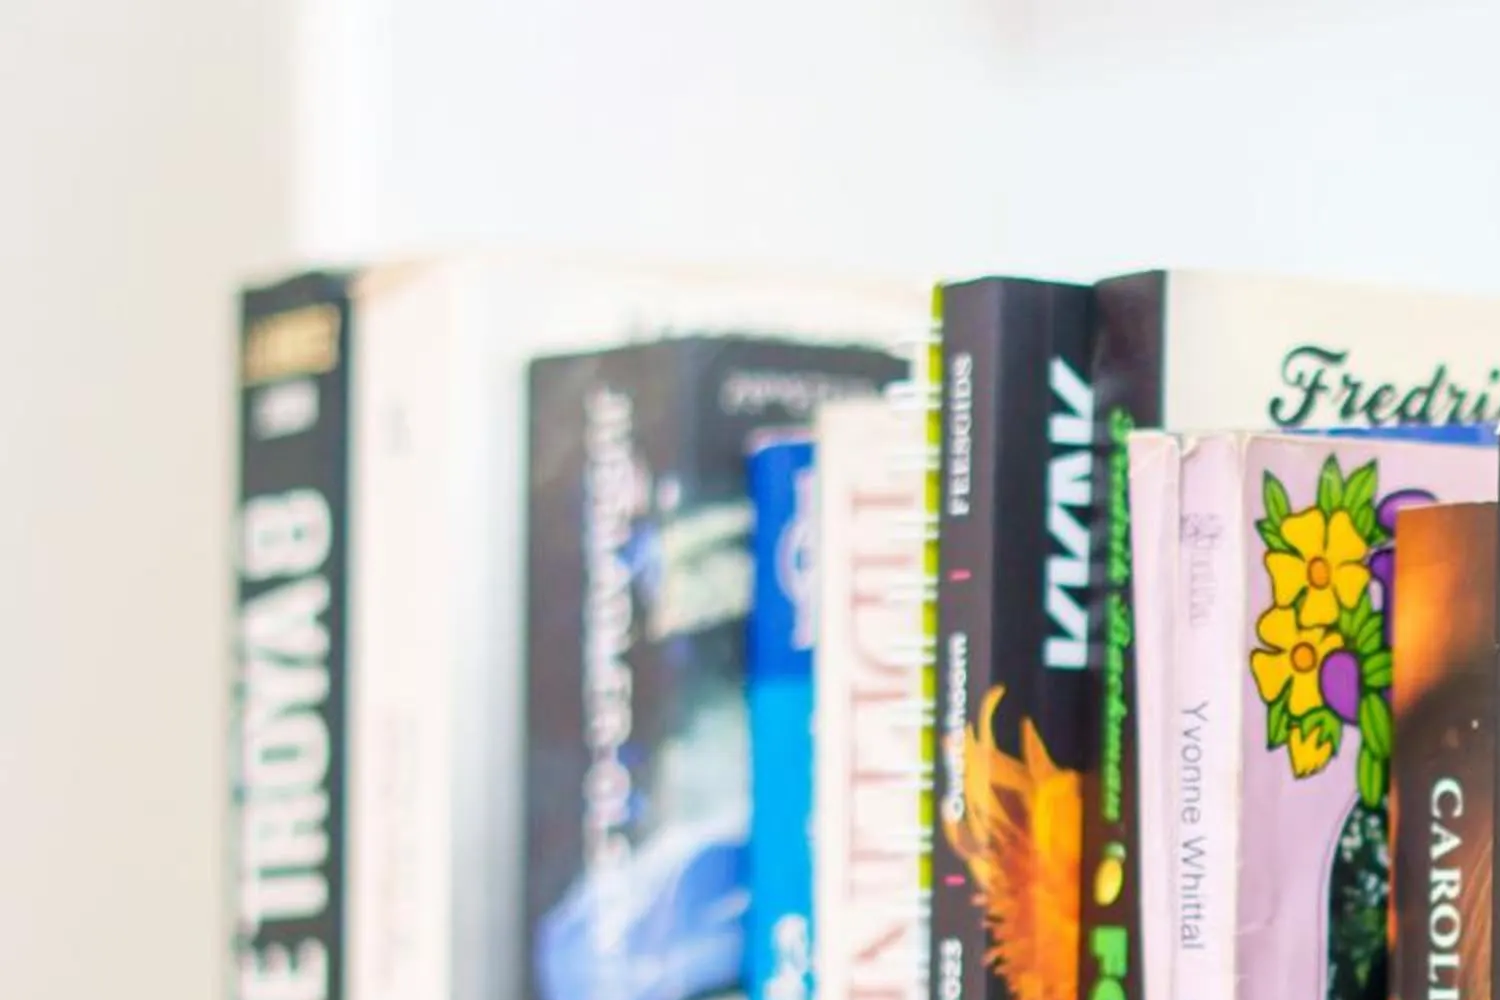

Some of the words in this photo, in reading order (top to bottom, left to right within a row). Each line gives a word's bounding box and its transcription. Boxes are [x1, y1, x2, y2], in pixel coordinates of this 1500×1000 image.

[947, 351, 974, 517] FEESGIDS
[1180, 701, 1209, 825] Yvonne
[1180, 834, 1209, 951] Whittal
